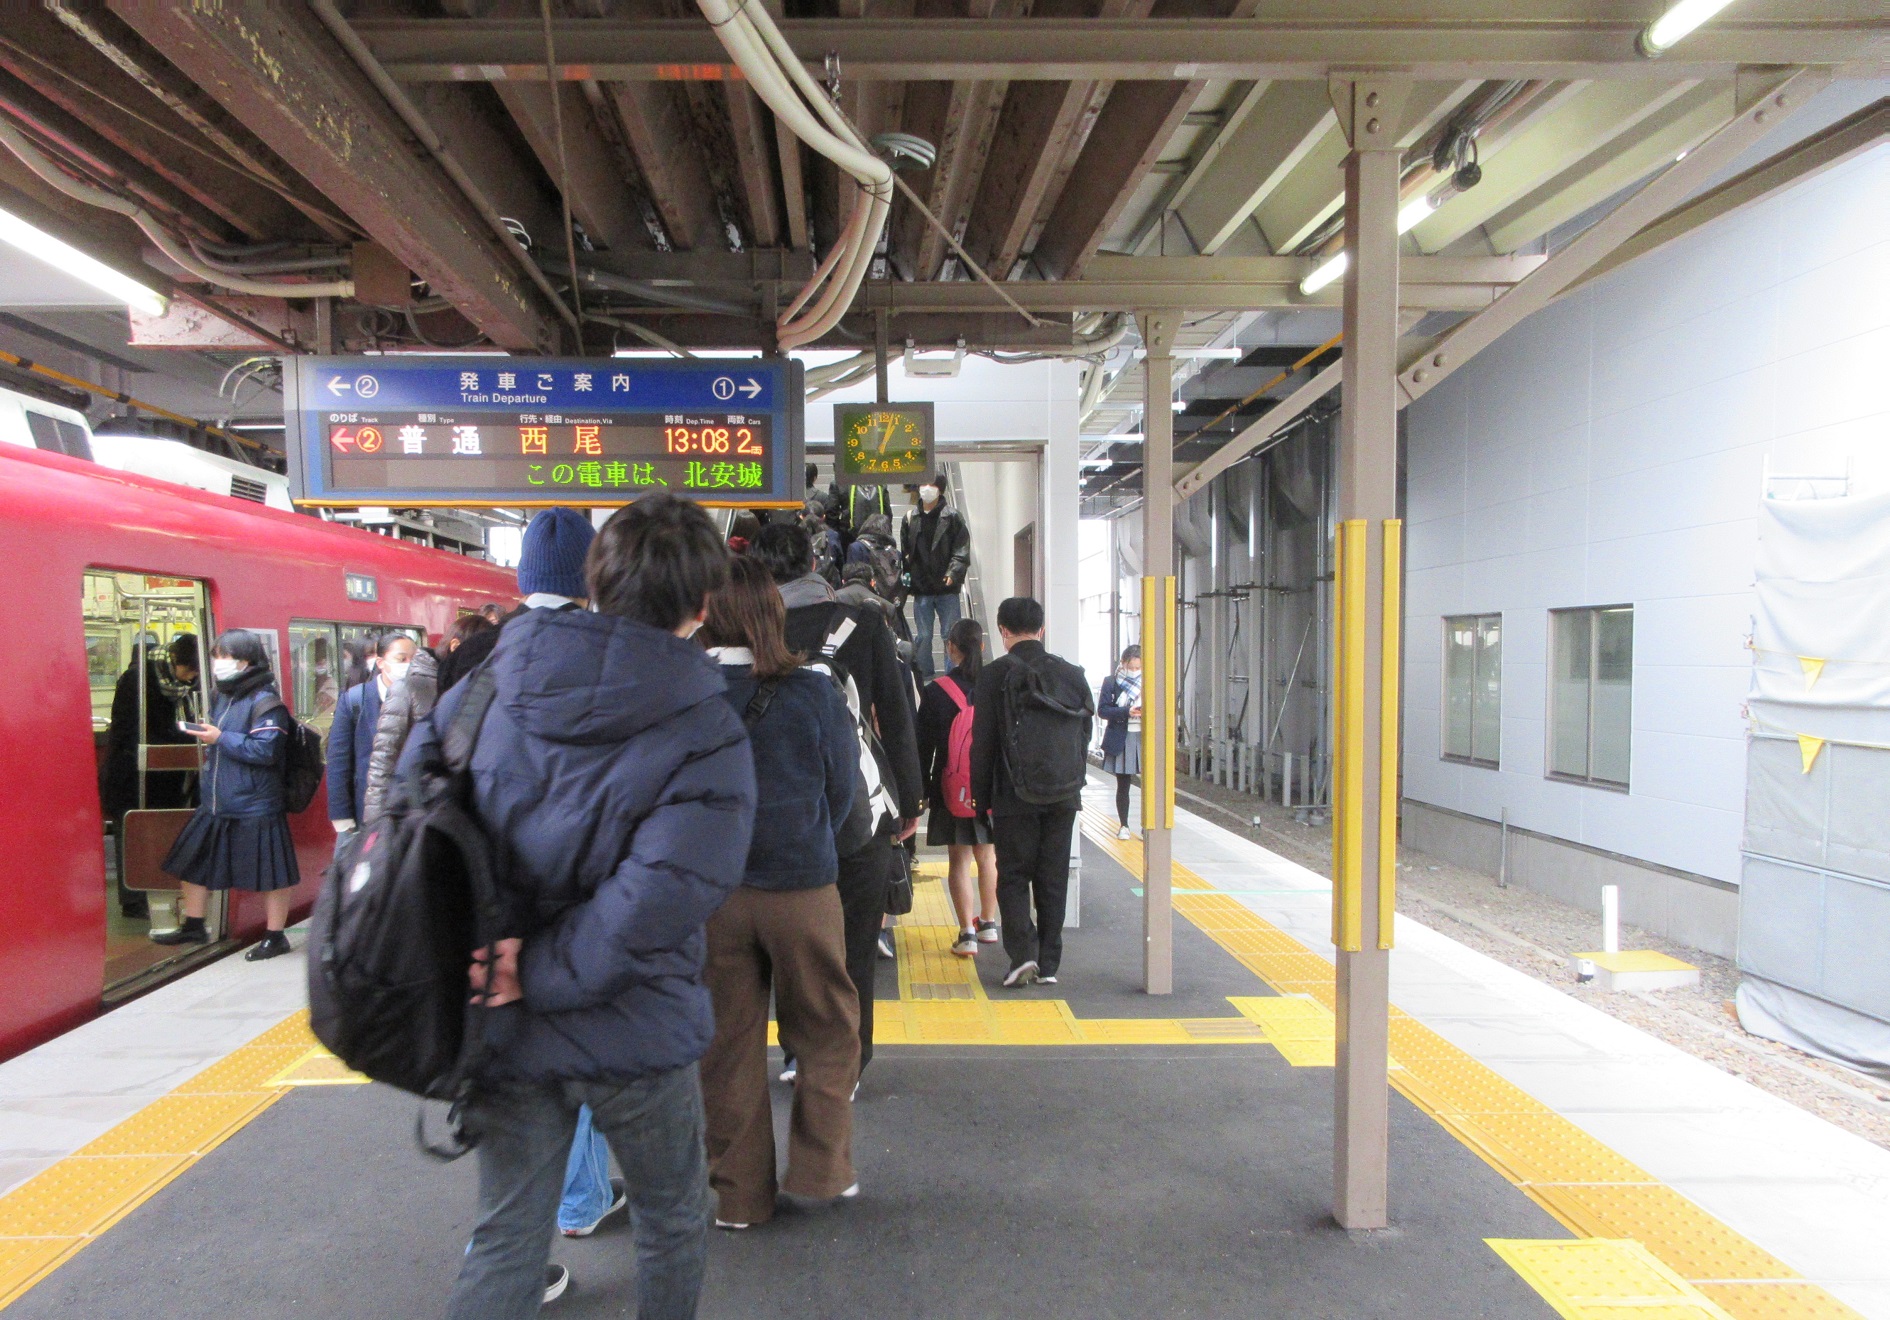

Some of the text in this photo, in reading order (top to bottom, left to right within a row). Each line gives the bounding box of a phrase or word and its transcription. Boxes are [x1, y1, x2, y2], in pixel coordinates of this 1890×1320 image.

[460, 372, 630, 392] 発車ご案内
[461, 393, 547, 404] Train Departure
[329, 413, 358, 423] のりば
[418, 413, 437, 423] 種別
[519, 414, 563, 424] 行先・経由
[664, 415, 684, 424] 時刻
[727, 415, 745, 425] 両数
[857, 426, 868, 434] 10
[398, 425, 482, 455] 普通
[519, 425, 602, 455] 西尾
[664, 428, 730, 453] 13:08
[869, 459, 877, 467] 7
[881, 461, 889, 469] 6
